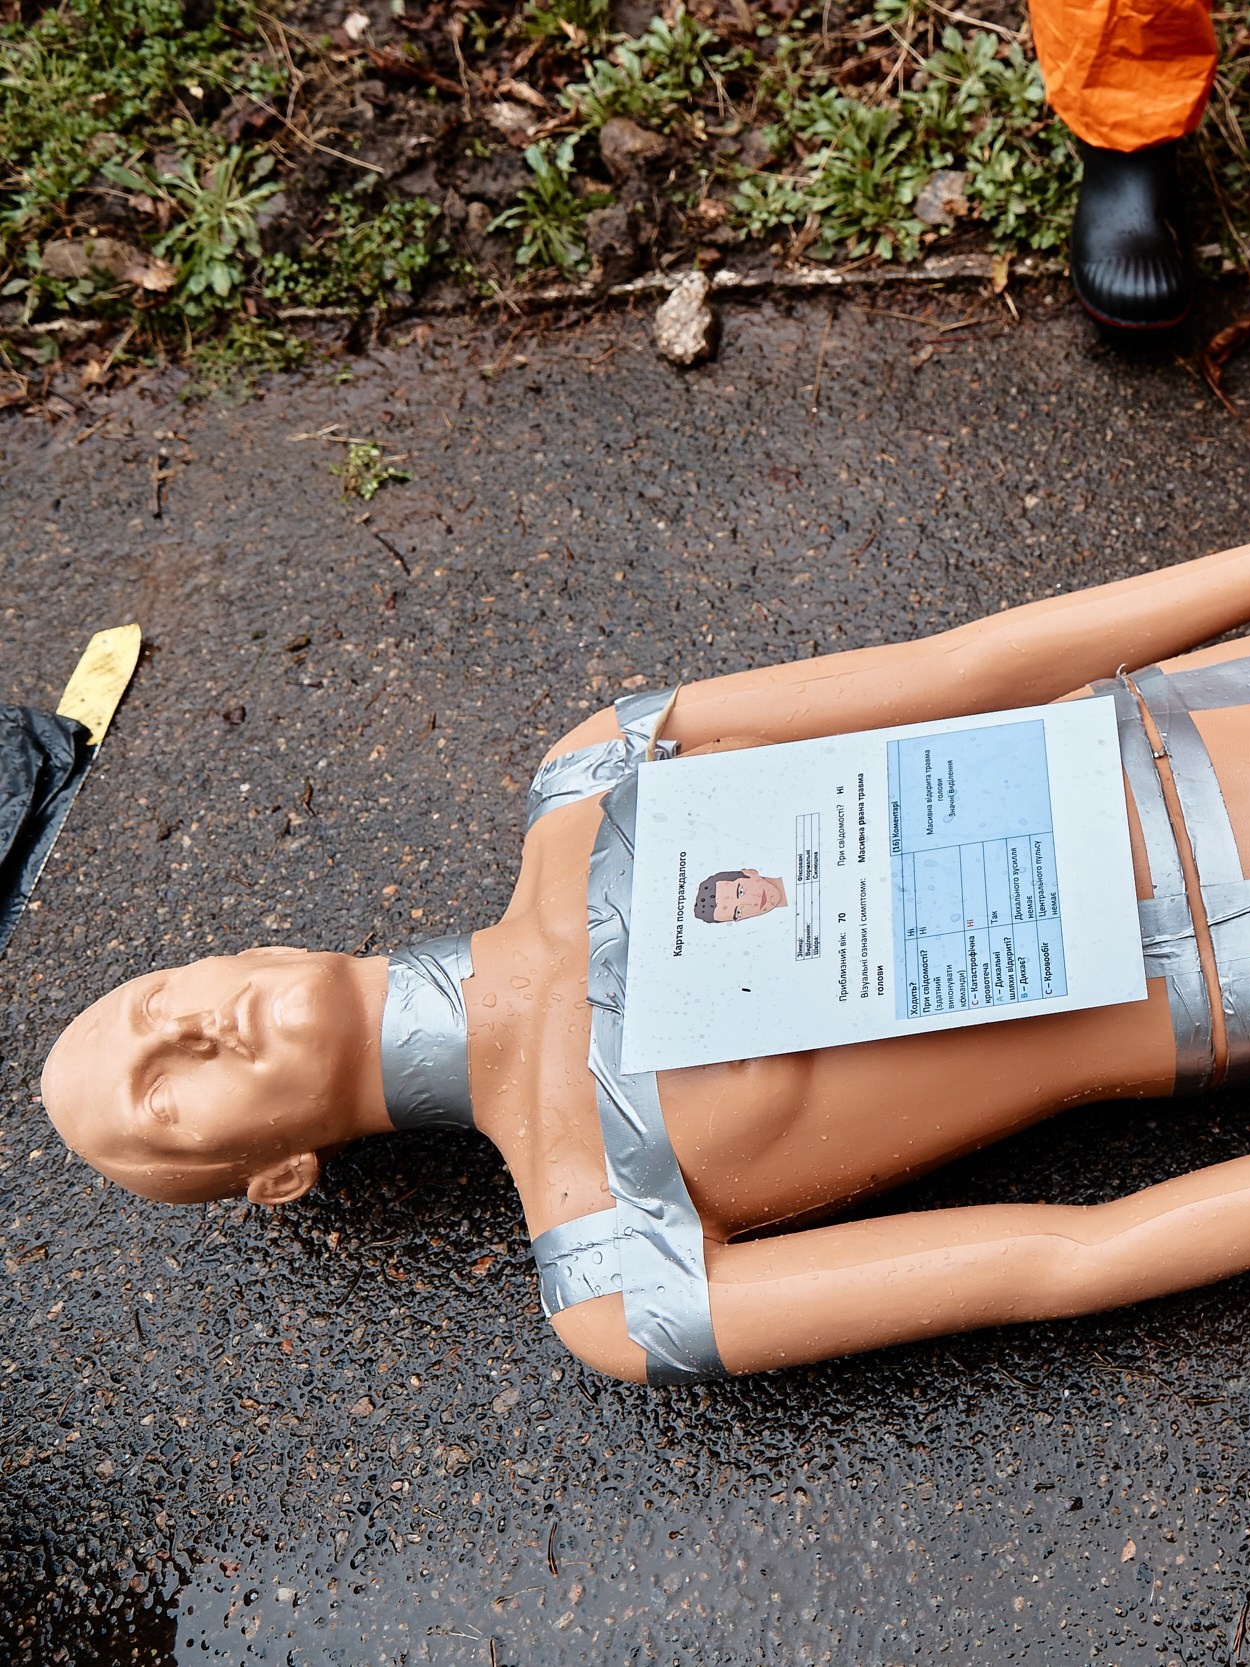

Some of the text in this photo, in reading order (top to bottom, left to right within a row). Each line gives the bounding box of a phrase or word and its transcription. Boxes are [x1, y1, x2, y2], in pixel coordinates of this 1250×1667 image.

[858, 773, 866, 801] травма
[924, 749, 934, 835] Масивна відкрита травма
[947, 760, 955, 794] виділення
[836, 786, 847, 867] При свідомості? Ні
[858, 802, 866, 826] рвана
[891, 801, 902, 853] (16) Коментарі
[858, 827, 866, 863] Масивна
[1011, 847, 1024, 921] Дихального зусилля
[1034, 840, 1047, 917] Центрального пульсу
[673, 851, 687, 957] Картка постраждалого
[990, 910, 998, 925] Так
[1026, 895, 1034, 919] немає
[1050, 892, 1058, 915] немає
[907, 928, 915, 937] Ні
[919, 926, 927, 935] Ні
[967, 919, 974, 927] Ні
[838, 912, 849, 1002] Приблизний вік: 70
[968, 935, 978, 992] Катастрофічна
[992, 951, 1004, 988] Дихальні
[1003, 937, 1016, 1000] шляхи відкриті?
[1017, 957, 1029, 985] Дихає?
[1041, 942, 1053, 982] Кровообіг
[860, 959, 870, 998] Візуальні
[920, 950, 932, 1013] При свідомості?
[933, 976, 944, 1011] (здатний
[946, 964, 955, 1009] виконувати
[956, 970, 967, 1007] команди)
[982, 962, 992, 1004] кровотеча
[909, 982, 919, 1015] Ходить?
